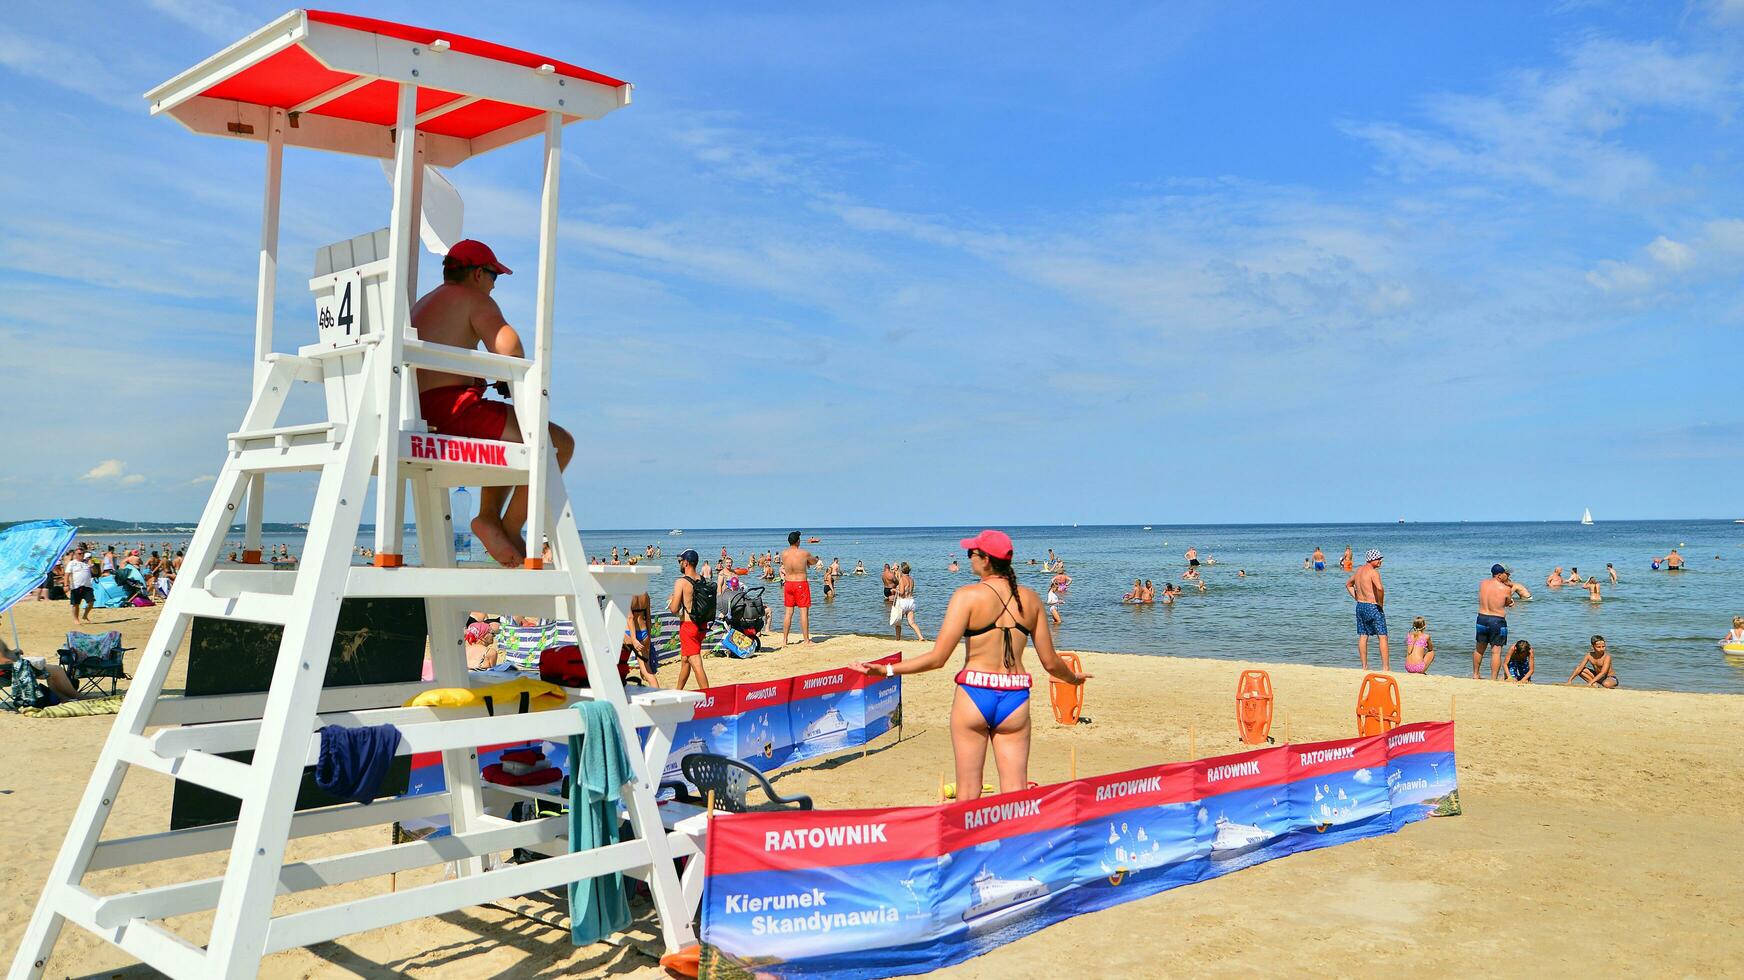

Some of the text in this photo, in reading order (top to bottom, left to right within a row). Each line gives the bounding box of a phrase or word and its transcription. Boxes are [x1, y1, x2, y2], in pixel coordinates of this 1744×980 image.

[338, 282, 353, 335] 4
[411, 436, 508, 466] RATOWNIK
[965, 671, 1030, 687] RATOWNIK
[1300, 747, 1356, 766] RATOWNIK
[1207, 761, 1260, 783] RATOWNIK
[1096, 776, 1161, 802] RATOWNIK
[965, 799, 1042, 830] RATOWNIK
[764, 823, 887, 851] RATOWNIK
[725, 888, 826, 914] Kierunek
[751, 905, 899, 935] Skandynawia
